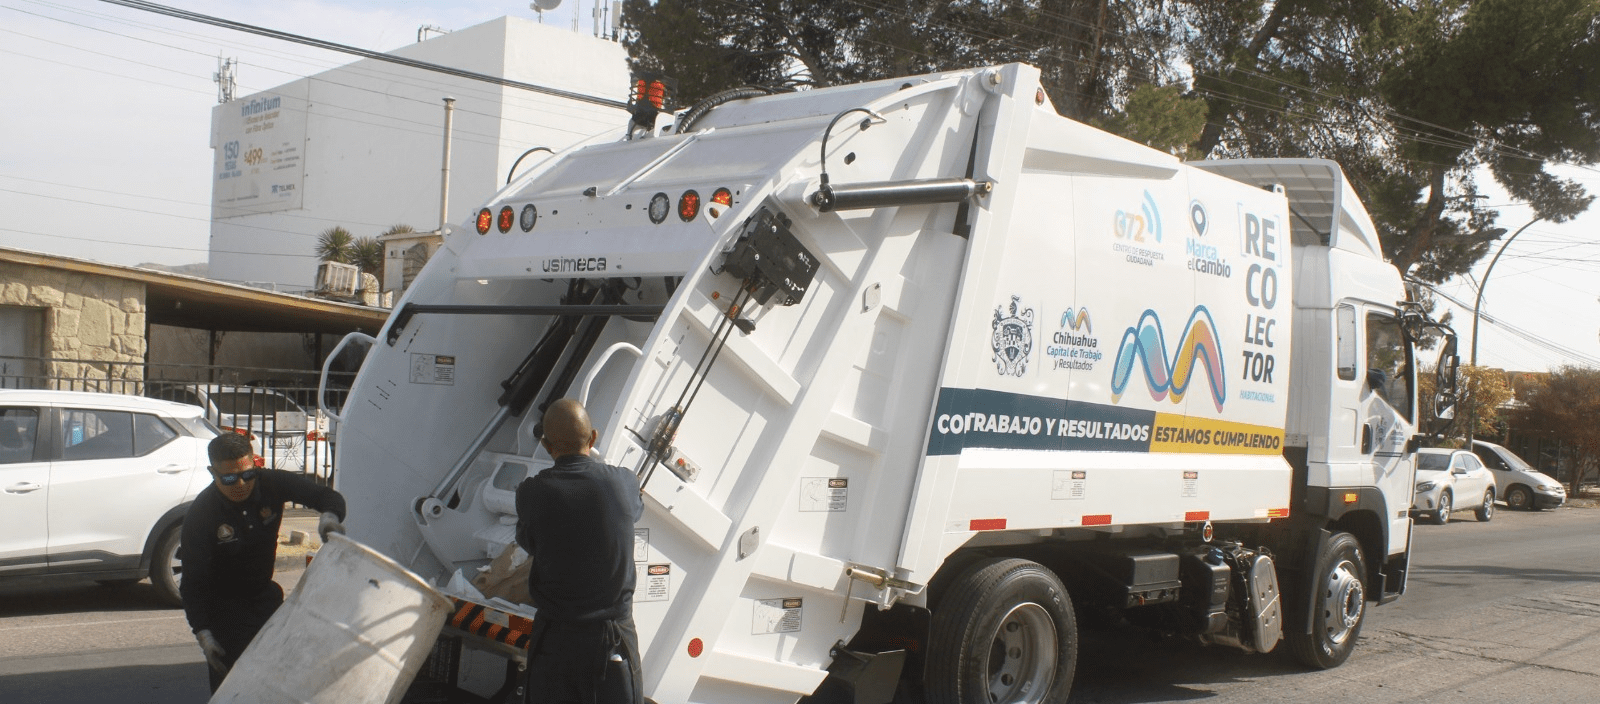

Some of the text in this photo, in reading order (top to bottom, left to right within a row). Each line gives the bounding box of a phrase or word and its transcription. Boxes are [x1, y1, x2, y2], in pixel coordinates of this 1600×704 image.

[241, 96, 280, 117] infinitum
[224, 140, 239, 160] 150
[244, 147, 262, 166] $499
[1113, 243, 1132, 254] CENTRO
[1139, 248, 1164, 261] RESPUESTA
[1186, 237, 1217, 260] Marca
[542, 256, 607, 272] usimeca
[1126, 254, 1153, 266] CIUDADANA
[1187, 257, 1195, 271] el
[1053, 331, 1098, 348] Chihuahua
[1047, 345, 1102, 362] Capital de Trabajo
[1053, 358, 1093, 371] y Resultados
[1240, 389, 1275, 403] HABITACIONAL
[1046, 418, 1057, 436] Y
[1058, 418, 1150, 442] RESULTADOS
[1154, 426, 1280, 450] ESTAMOS CUMPLIENDO
